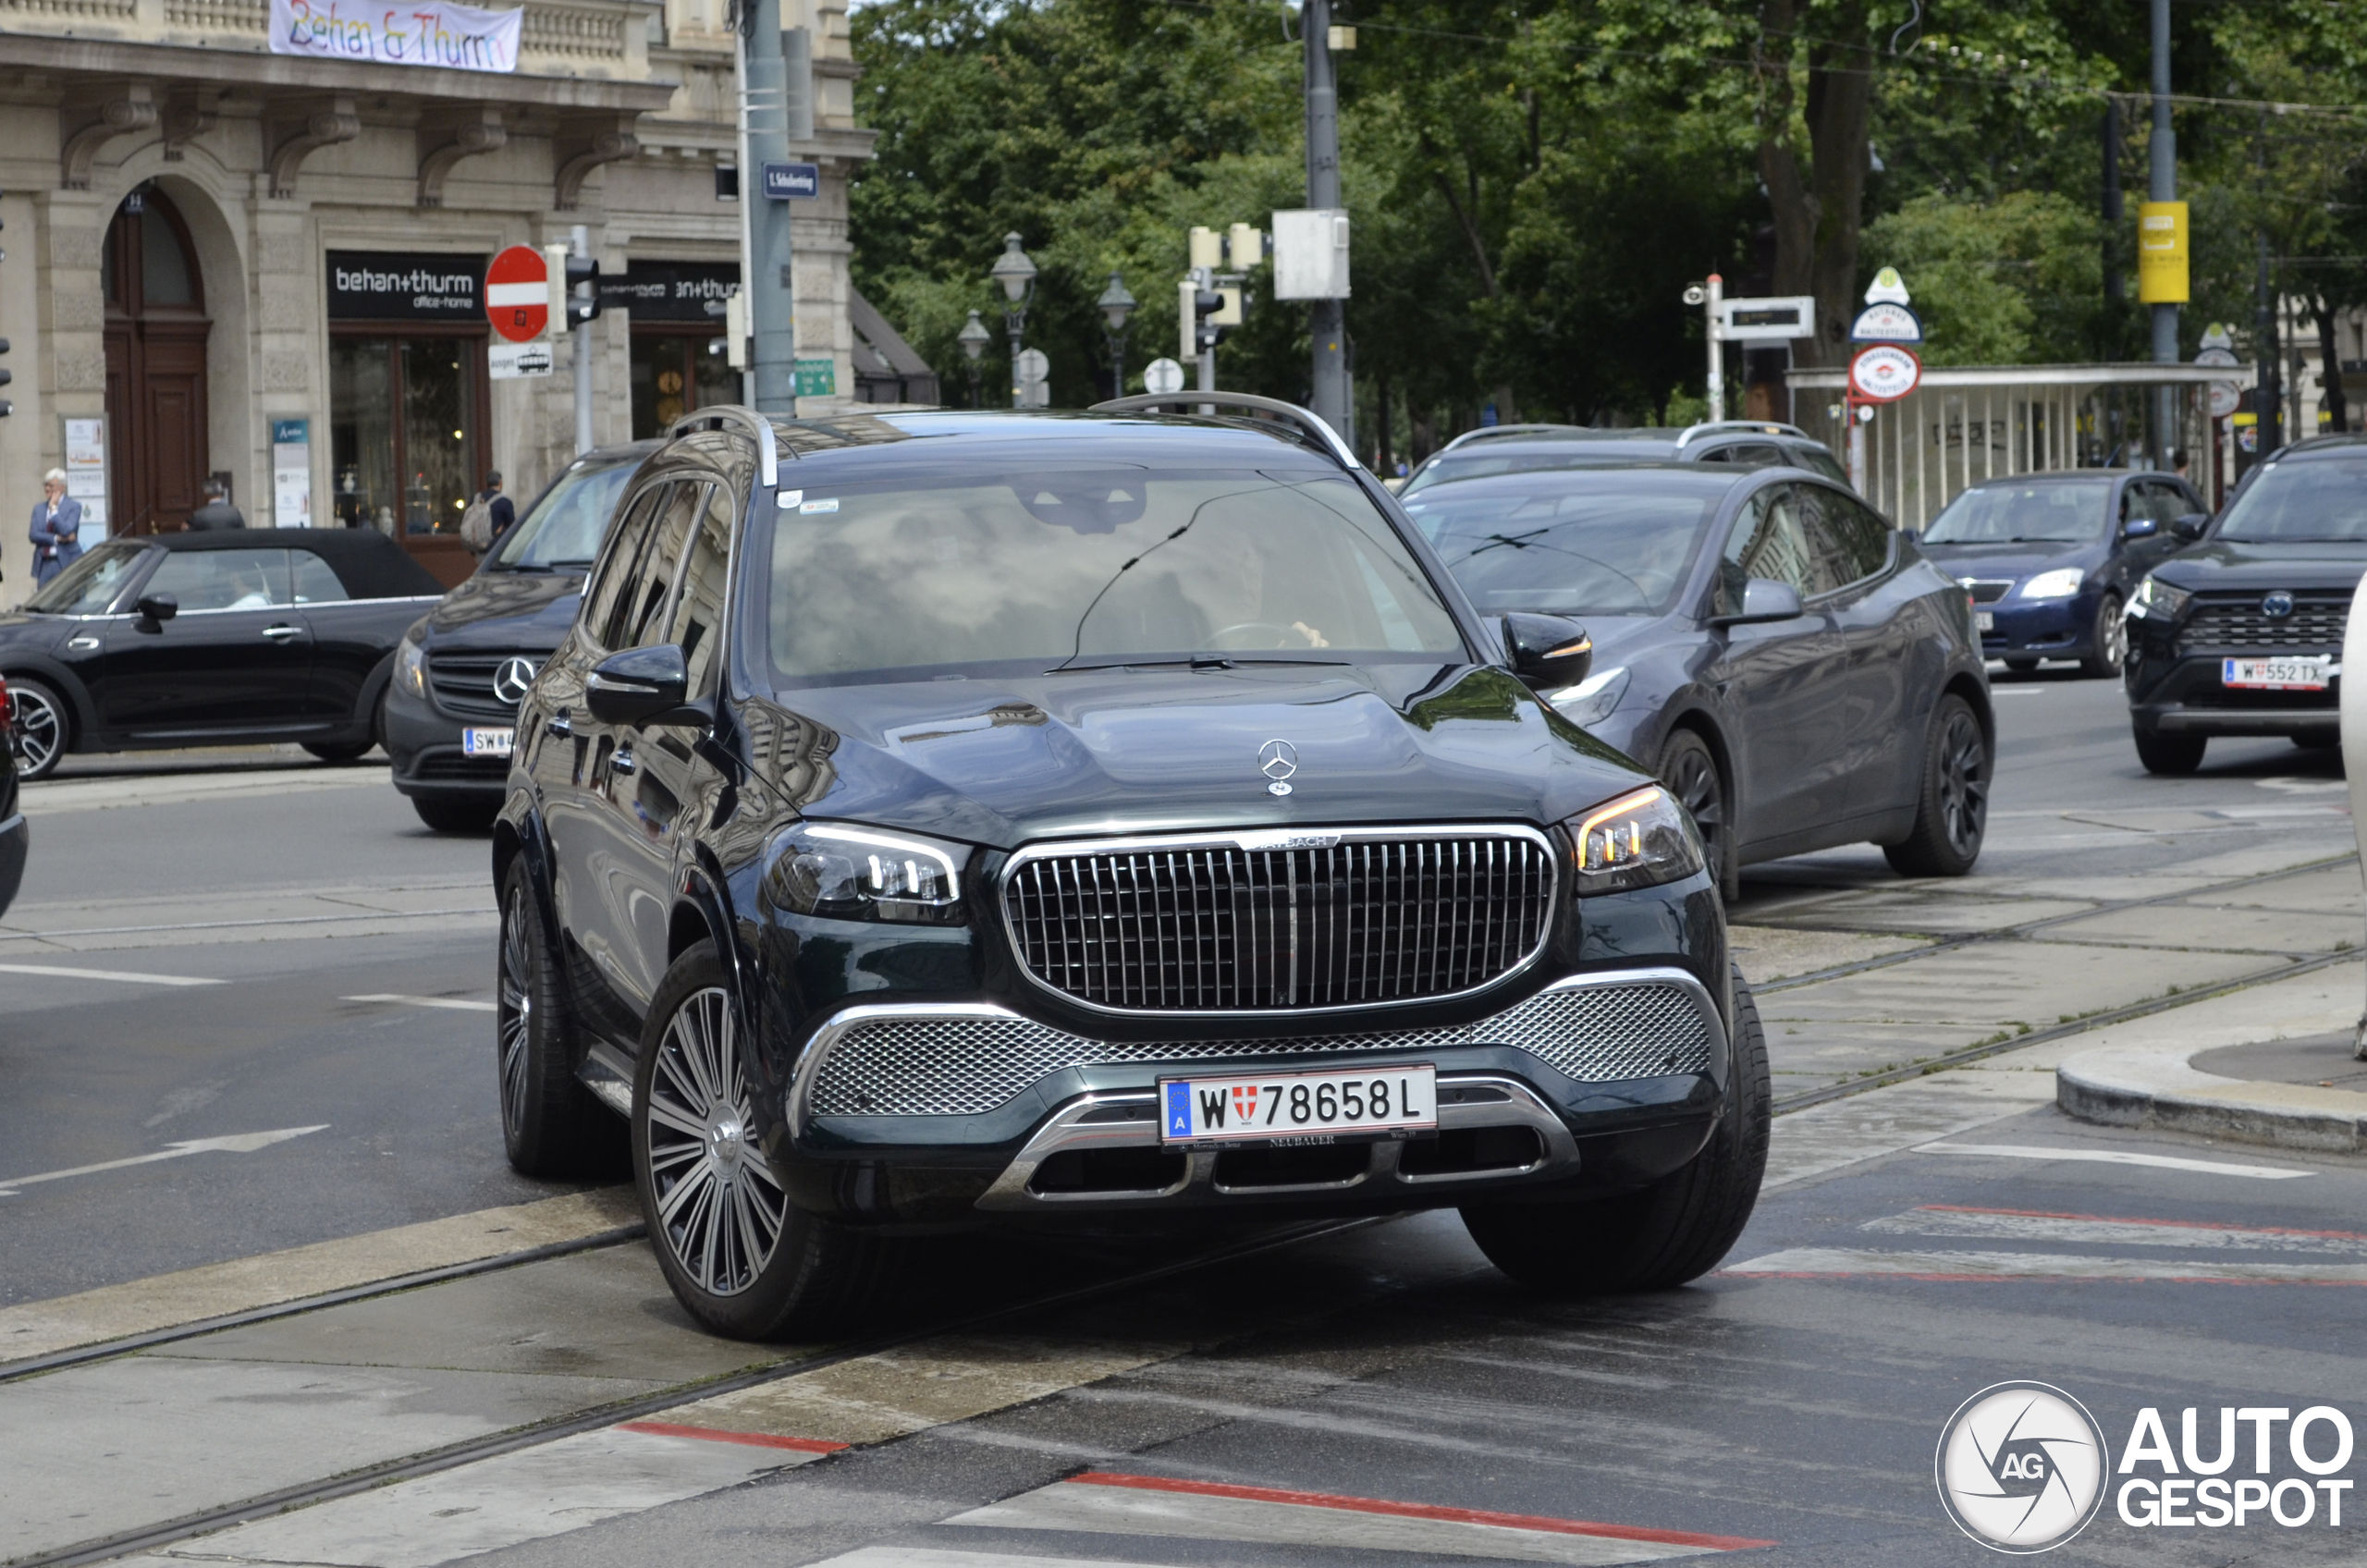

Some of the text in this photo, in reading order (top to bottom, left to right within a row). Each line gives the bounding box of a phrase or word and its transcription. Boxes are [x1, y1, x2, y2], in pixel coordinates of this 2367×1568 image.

[289, 0, 507, 67] Behan & Thurm
[336, 266, 473, 294] behan+thurm
[2243, 664, 2255, 680] W
[2267, 664, 2296, 680] 552
[475, 733, 495, 750] SW
[1199, 1078, 1420, 1129] W 78658 L
[1174, 1117, 1185, 1130] A
[1269, 1135, 1335, 1148] NEUBAUER
